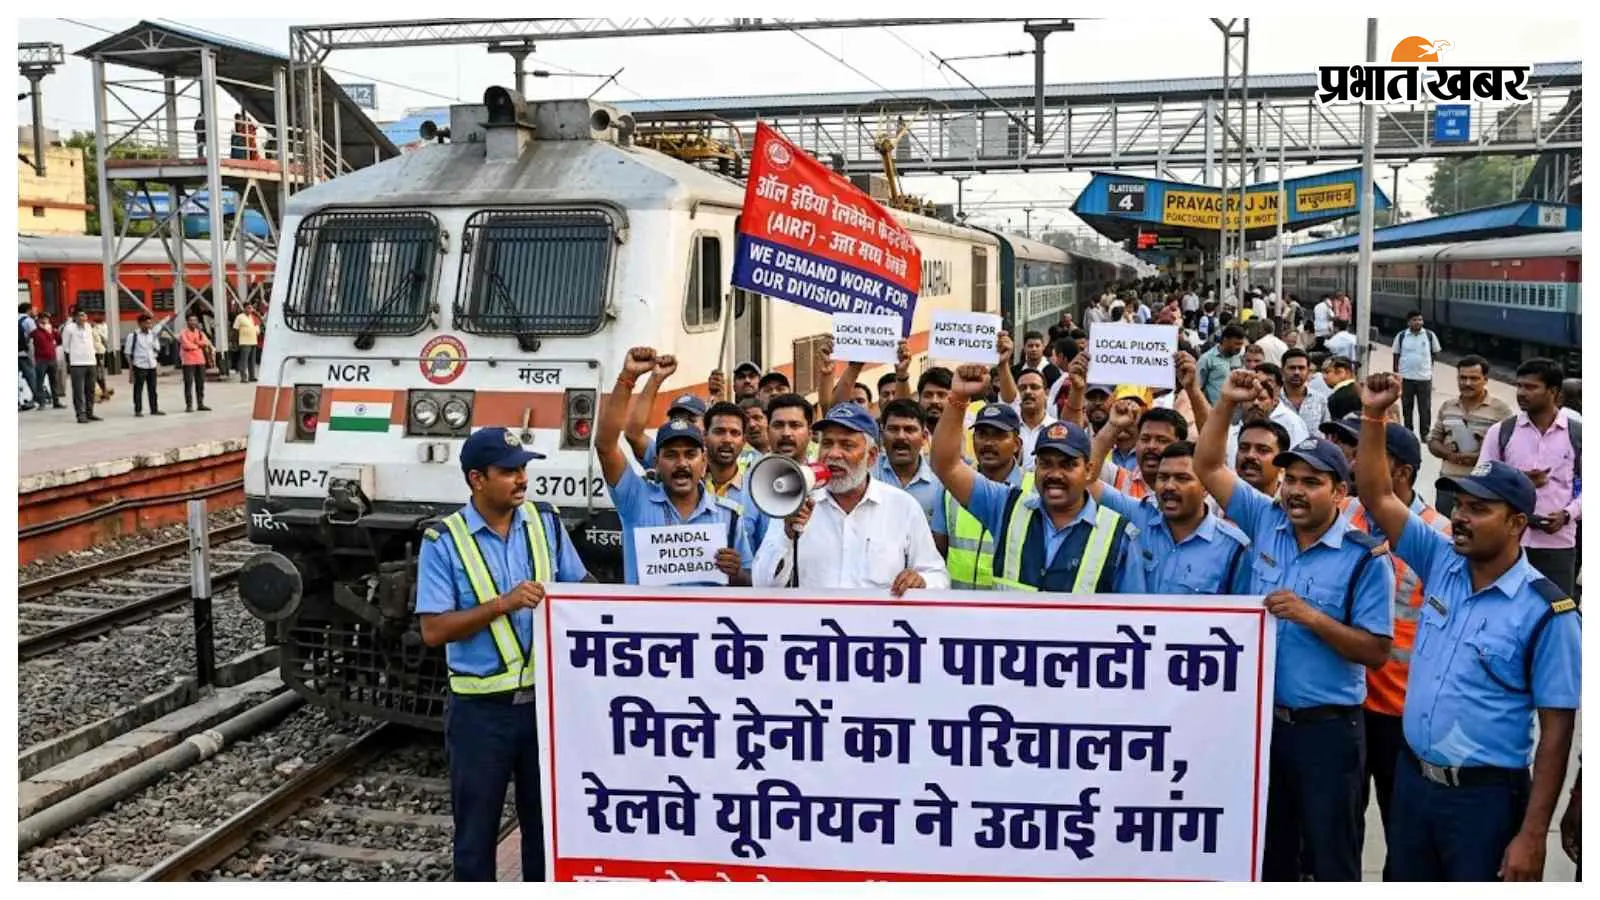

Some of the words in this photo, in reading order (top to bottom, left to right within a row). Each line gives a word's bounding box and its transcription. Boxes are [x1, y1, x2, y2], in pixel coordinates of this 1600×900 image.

[756, 175, 789, 202] ऑल
[791, 183, 829, 216] इंडिया
[1118, 194, 1135, 210] 4
[767, 211, 816, 246] (AIRF)
[750, 243, 773, 265] WE
[776, 250, 838, 283] DEMAND
[840, 269, 883, 299] WORK
[885, 285, 908, 309] FOR
[752, 268, 784, 291] OUR
[787, 277, 851, 311] DIVISION
[852, 297, 901, 317] PILO
[836, 324, 862, 335] LOCAL
[935, 321, 973, 333] JUSTICE
[975, 324, 996, 335] FOR
[836, 336, 862, 346] LOCAL
[865, 338, 895, 348] TRAINS
[935, 336, 955, 346] NCR
[958, 339, 993, 350] PILOTS
[1095, 339, 1128, 350] LOCAL
[1130, 340, 1169, 352] PILOTS,
[1095, 354, 1128, 365] LOCAL
[1131, 356, 1169, 367] TRAINS
[328, 364, 371, 383] NCR
[518, 363, 562, 385] मंडल
[267, 468, 329, 488] WAP-7
[535, 475, 604, 498] 37012
[650, 531, 711, 545] MANDAL
[659, 547, 705, 559] PILOTS
[567, 614, 699, 679] मंडल
[711, 616, 768, 681] के
[781, 618, 926, 684] लोको
[940, 624, 1156, 690] पायलटों
[1166, 627, 1244, 692] को
[609, 695, 720, 759] मिले
[733, 697, 834, 772] ट्रेनों
[841, 714, 916, 764] का
[929, 703, 1189, 783] परिचालन,
[582, 772, 700, 837] रेलवे
[713, 779, 901, 859] यूनियन
[914, 783, 958, 847] ने
[972, 787, 1101, 861] उठाई
[1114, 784, 1224, 854] मांग
